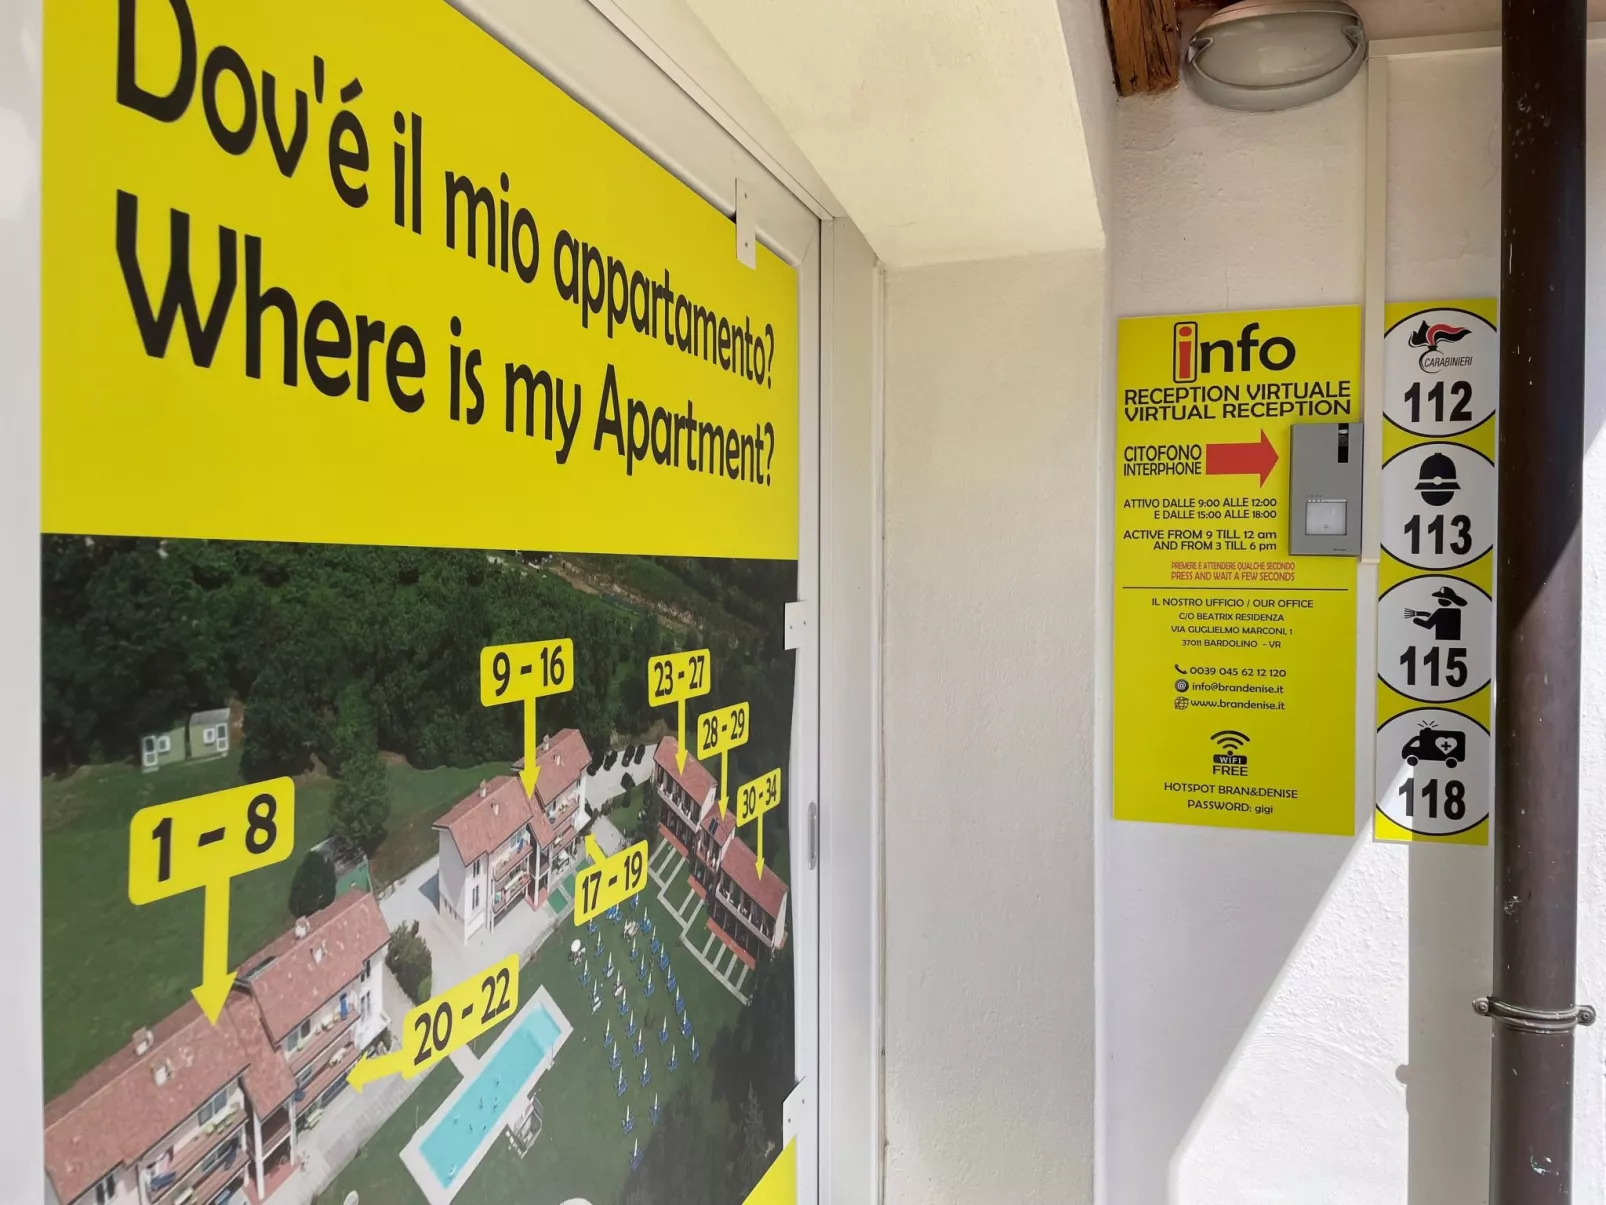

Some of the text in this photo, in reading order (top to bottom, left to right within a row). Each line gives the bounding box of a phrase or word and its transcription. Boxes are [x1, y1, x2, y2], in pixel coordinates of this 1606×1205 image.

[116, 0, 774, 389] Dov'é il mio appartamento?
[116, 188, 775, 486] Where is my Apartment?
[1178, 322, 1296, 379] info
[1424, 356, 1473, 368] CARABINIERI
[1124, 381, 1351, 405] RECEPTION VIRTUALE
[1404, 380, 1473, 423] 112
[1124, 400, 1351, 422] VIRTUAL RECEPTION
[1124, 444, 1202, 462] CITOFONO
[1123, 462, 1202, 476] INTERPHONE
[1123, 498, 1277, 508] ATTIVO DALLE 9:00 ALLE 12:00
[1154, 510, 1277, 519] E DALLE 15:00 ALLE 18:00
[1123, 529, 1277, 540] ACTIVE FROM 9 TILL 12 am
[1404, 514, 1473, 555] 113
[1153, 541, 1277, 552] AND FROM 3 TILL 6 pm
[1171, 561, 1295, 571] PREMERE E ATTENDERE QUALCHE SECONDO
[1171, 572, 1295, 581] PRESS AND WAIT A FEW SECONDS
[1151, 598, 1160, 606] IL
[1162, 598, 1203, 607] NOSTRO
[1205, 598, 1244, 607] UFFICIO
[1253, 599, 1275, 608] OUR
[1277, 600, 1314, 608] OFFICE
[1179, 612, 1284, 622] C/O BEATRIX RESIDENZA
[1171, 625, 1186, 633] VIA
[1188, 626, 1240, 634] GUGLIELMO
[1242, 627, 1287, 636] MARCONI,
[1204, 640, 1258, 648] BARDOLINO
[1268, 640, 1281, 648] VR
[493, 651, 510, 697] 9
[540, 645, 565, 687] 16
[1190, 667, 1286, 677] 0039 045 62 12 120
[1400, 646, 1468, 688] 115
[654, 660, 674, 698] 23
[689, 655, 705, 690] 27
[1192, 682, 1284, 694] info@brandenise.it
[1190, 699, 1285, 711] www.brandenise.it
[702, 716, 718, 750] 28
[730, 708, 745, 740] 29
[1212, 765, 1248, 776] FREE
[742, 785, 755, 818] 30
[766, 773, 777, 804] 34
[1164, 782, 1298, 799] HOTSPOT BRAN&DENISE
[1398, 777, 1466, 821] 118
[1187, 799, 1273, 814] PASSWORD: gigi
[152, 817, 172, 883] 1
[245, 793, 277, 854] 8
[581, 870, 601, 915] 17
[623, 851, 643, 891] 19
[412, 1001, 452, 1066] 20
[481, 967, 510, 1024] 22
